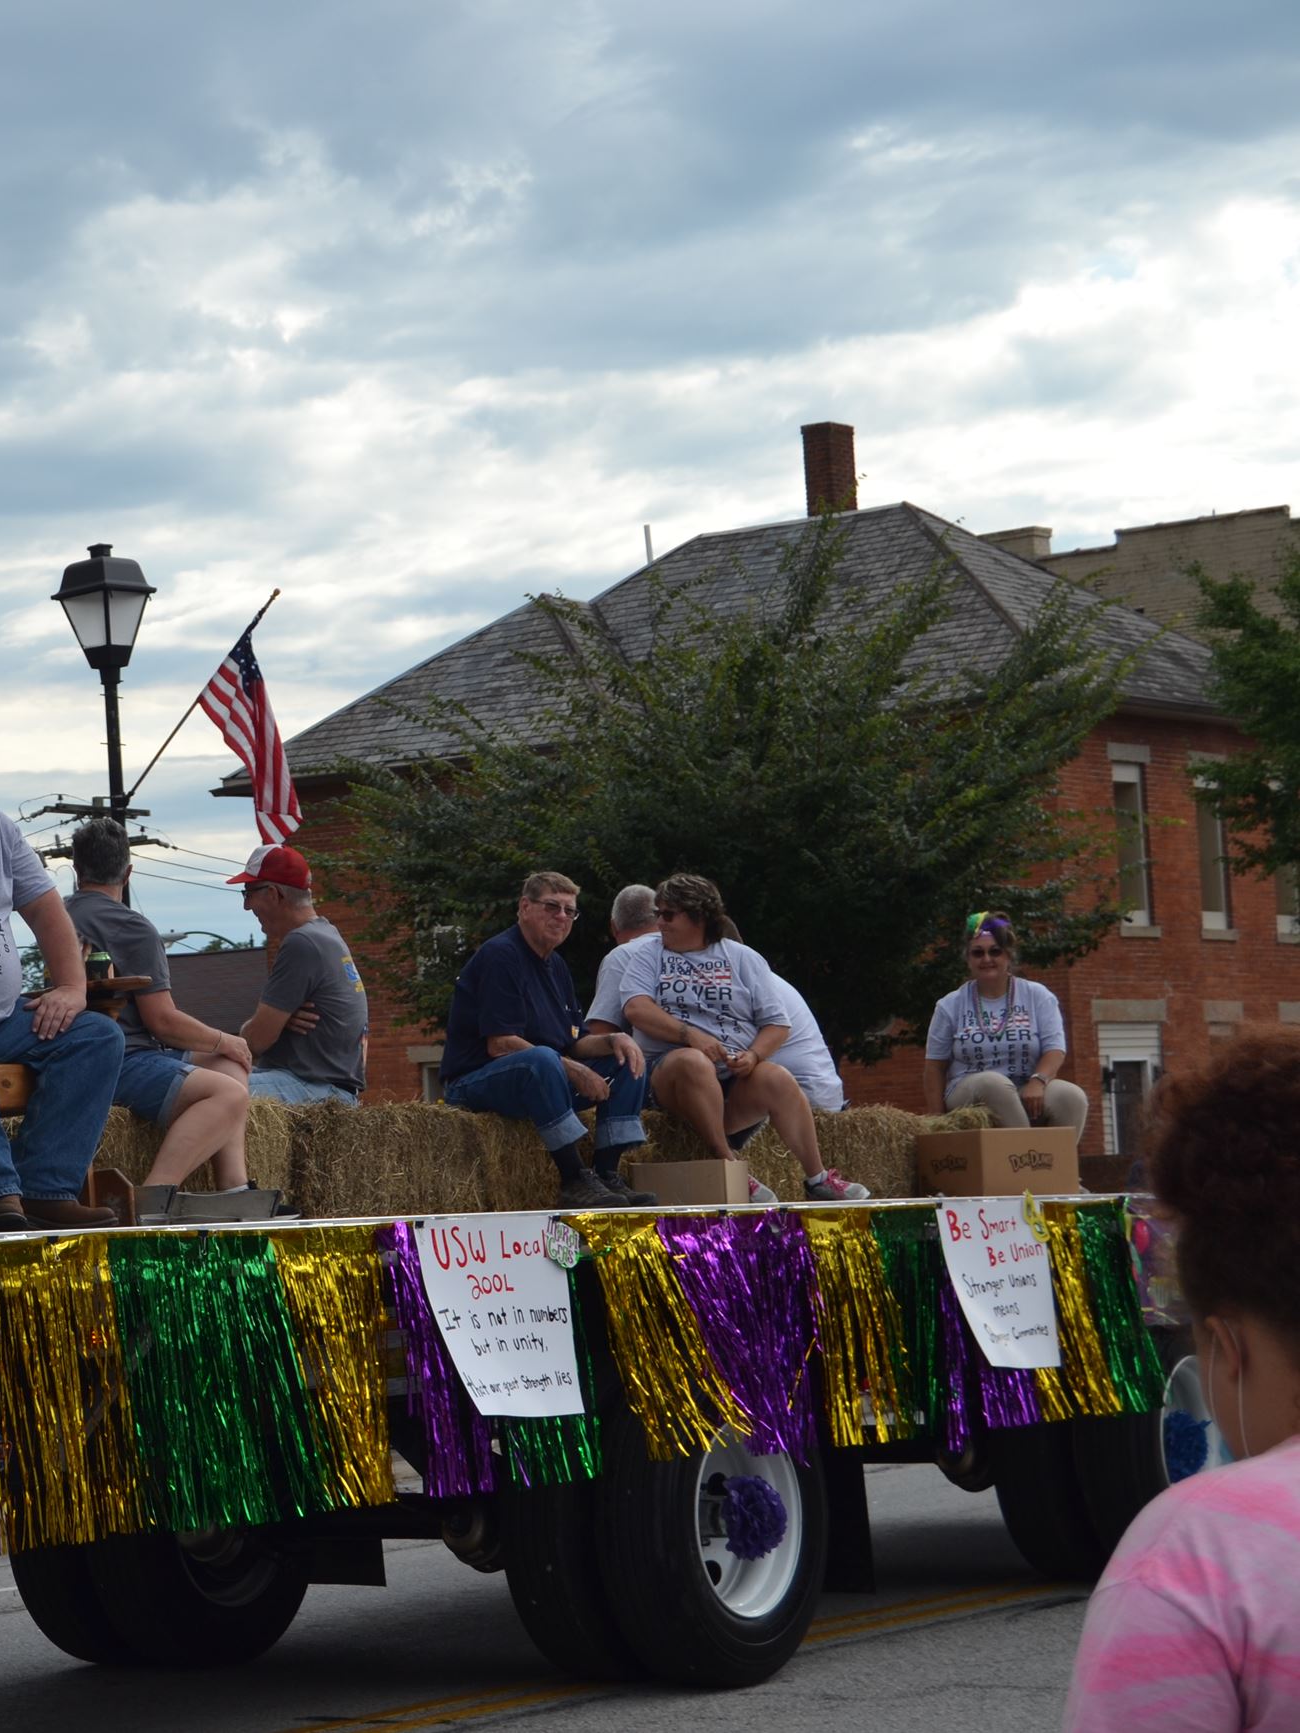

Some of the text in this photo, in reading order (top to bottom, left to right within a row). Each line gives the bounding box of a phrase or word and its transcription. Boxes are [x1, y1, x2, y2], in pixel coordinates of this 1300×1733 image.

[960, 1028, 1031, 1045] POWER
[946, 1208, 1016, 1242] Be Smart
[431, 1226, 548, 1270] USW Local
[987, 1242, 1044, 1267] Be Union
[962, 1273, 1037, 1298] Stronger Unions
[438, 1305, 568, 1331] It is not in numbers
[993, 1302, 1020, 1318] means
[471, 1338, 490, 1356] but
[497, 1336, 509, 1351] in
[490, 1380, 501, 1392] our
[502, 1380, 519, 1396] great
[555, 1370, 572, 1386] lies
